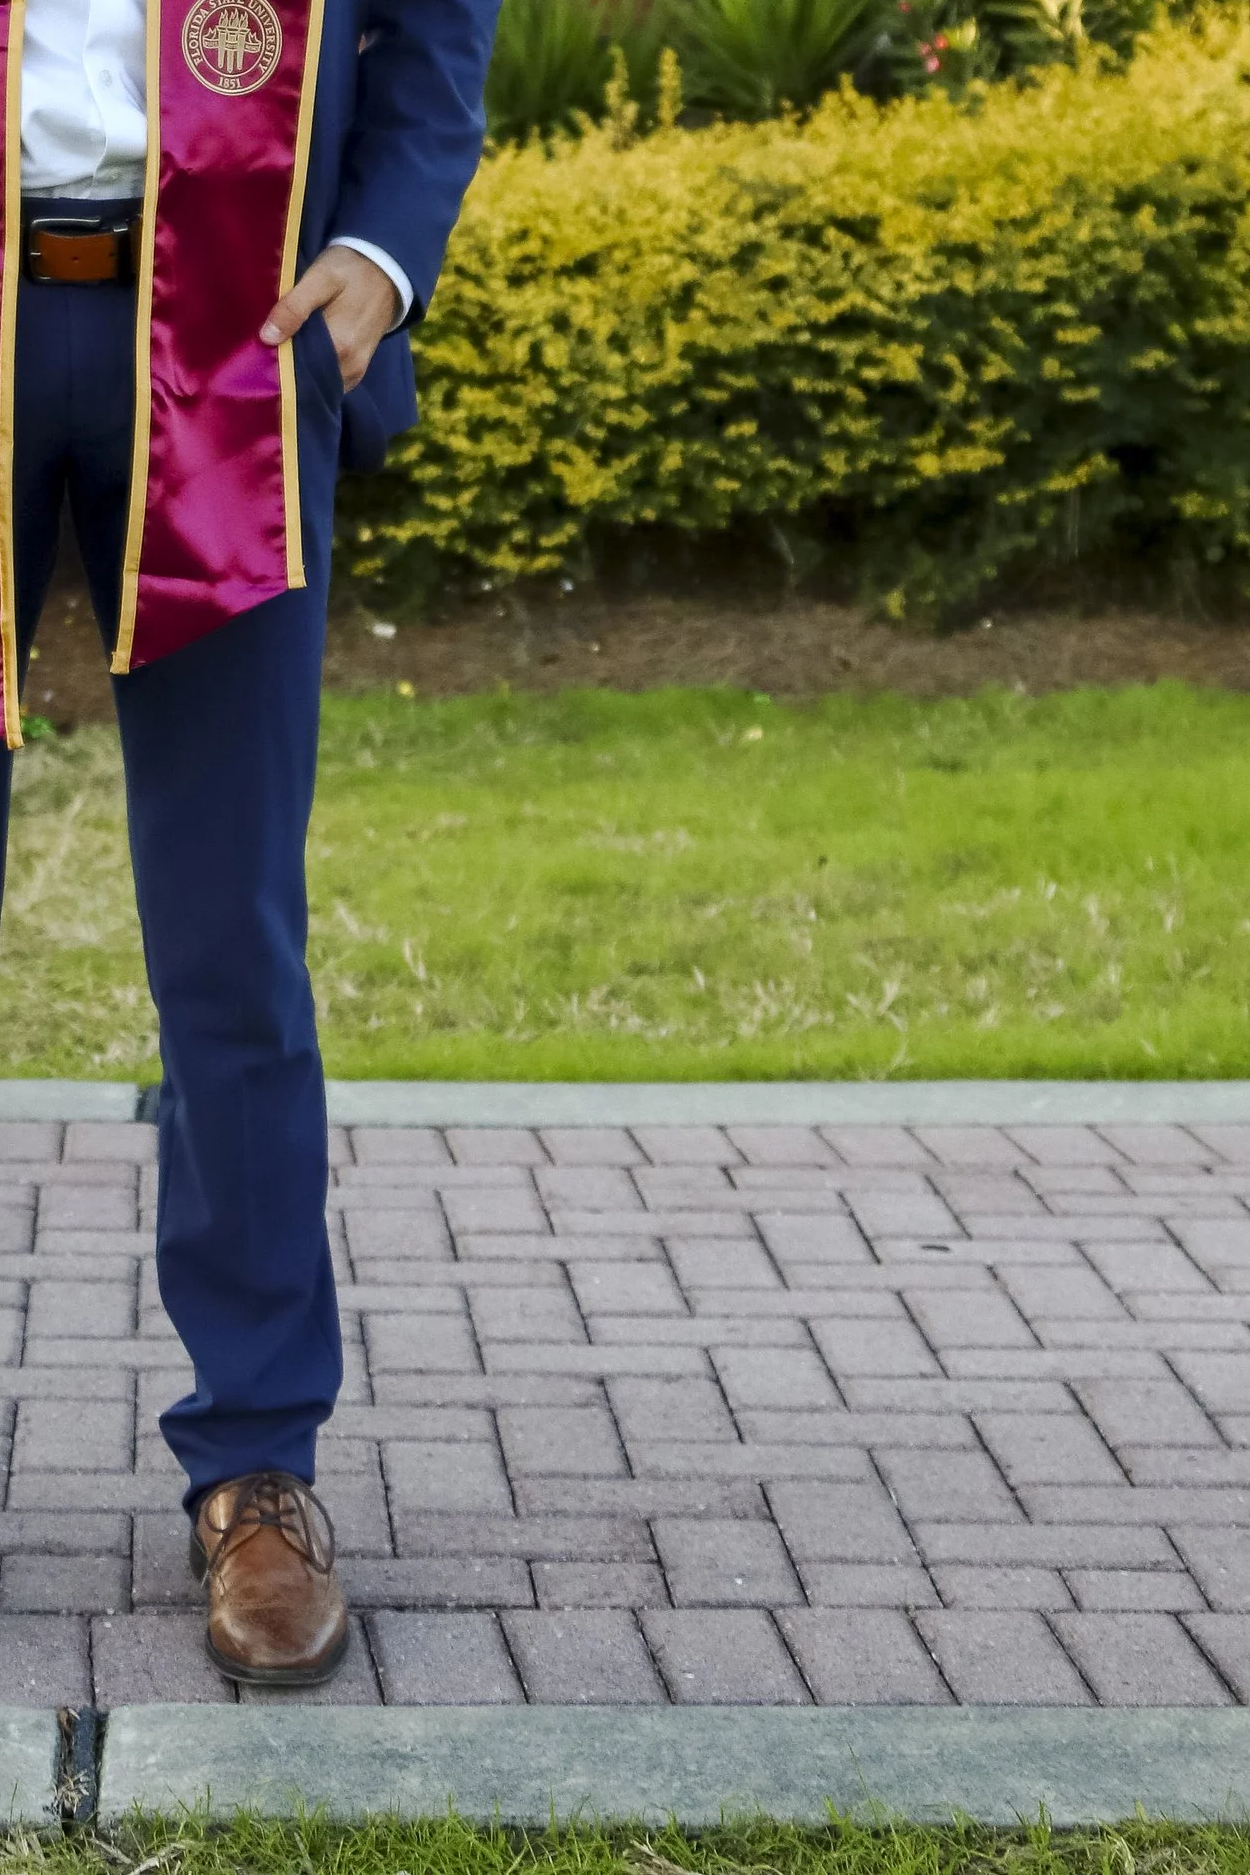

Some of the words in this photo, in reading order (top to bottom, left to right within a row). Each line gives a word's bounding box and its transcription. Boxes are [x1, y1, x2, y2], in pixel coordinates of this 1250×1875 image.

[189, 9, 209, 66] FLORIDA
[248, 0, 276, 74] UNIVERSITY
[218, 77, 242, 88] 1851
